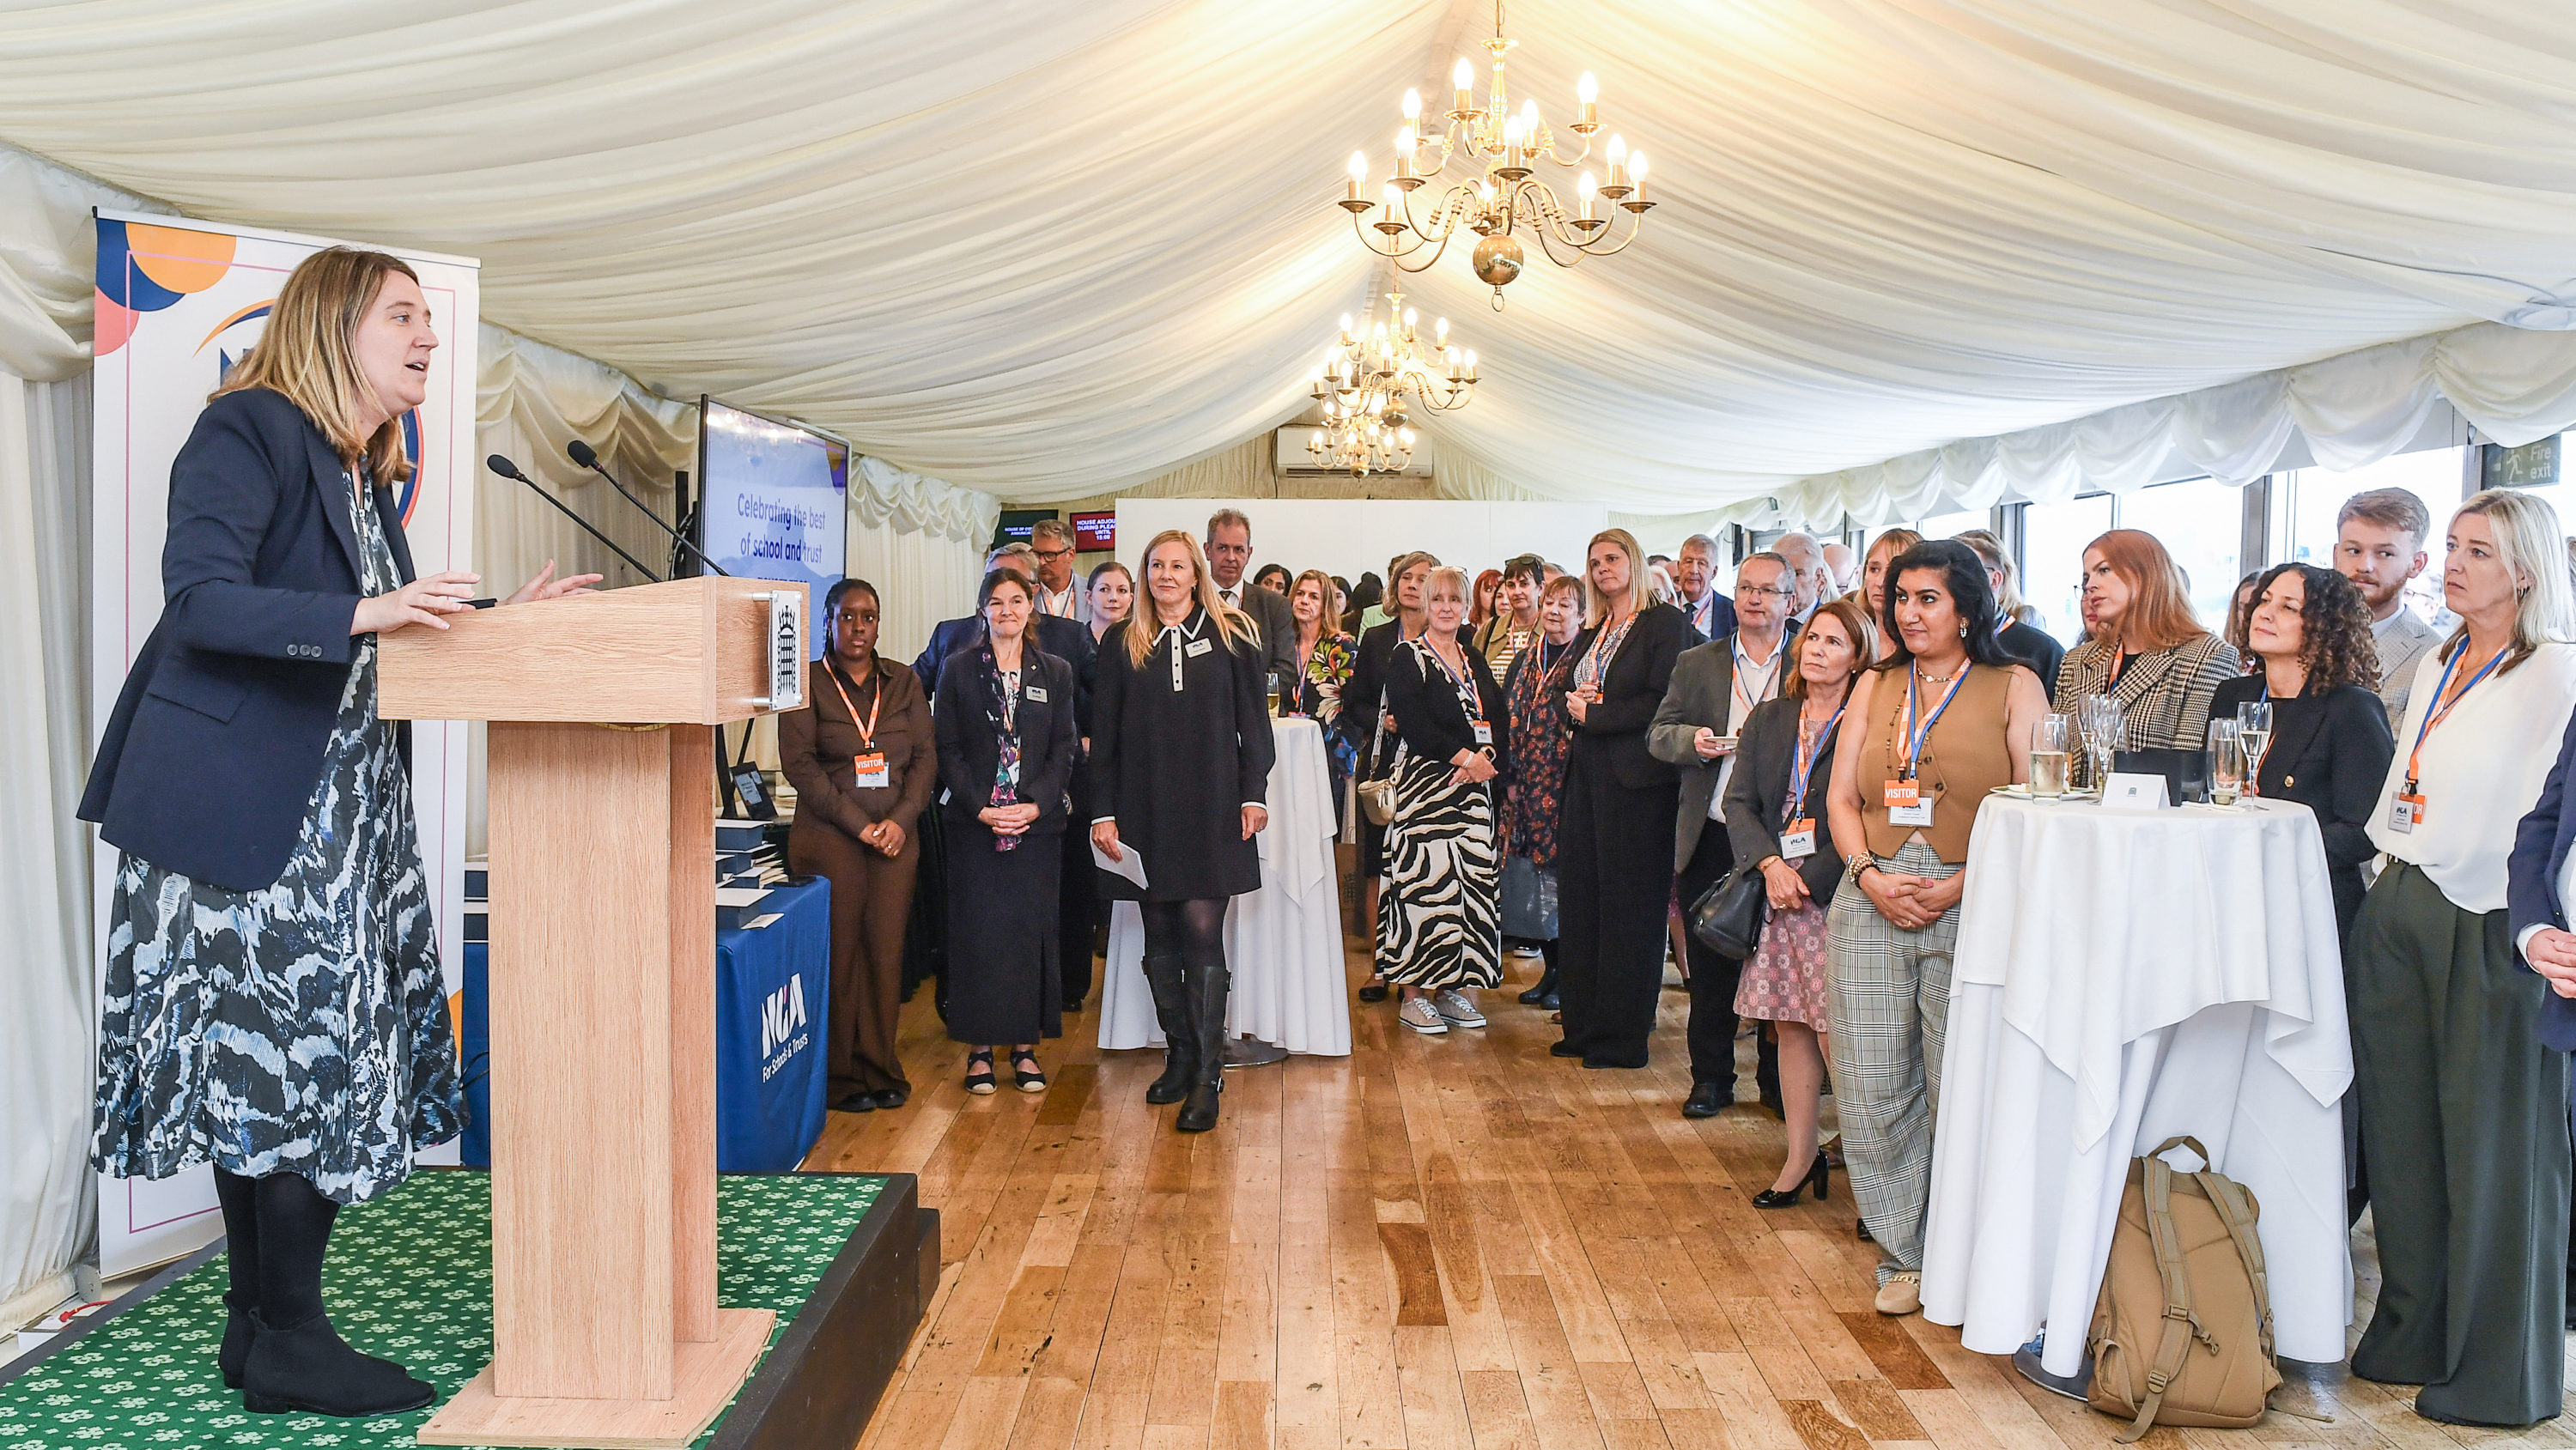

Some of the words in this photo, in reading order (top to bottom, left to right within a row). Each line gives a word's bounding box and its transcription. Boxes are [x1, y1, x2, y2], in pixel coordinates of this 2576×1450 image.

[2530, 446, 2552, 461] Fire
[2530, 463, 2551, 479] exit
[738, 493, 791, 531] Celebrating
[794, 503, 807, 527] the
[810, 506, 825, 530] best
[741, 531, 751, 556] of
[753, 533, 783, 560] school
[785, 538, 802, 561] and
[803, 541, 823, 564] trust
[856, 758, 884, 769] VISITOR
[1885, 787, 1917, 798] VISITOR
[762, 972, 807, 1060] NGA
[762, 1064, 773, 1083] For
[771, 1047, 788, 1076] Schools
[787, 1042, 793, 1059] &
[792, 1033, 809, 1054] Trusts
